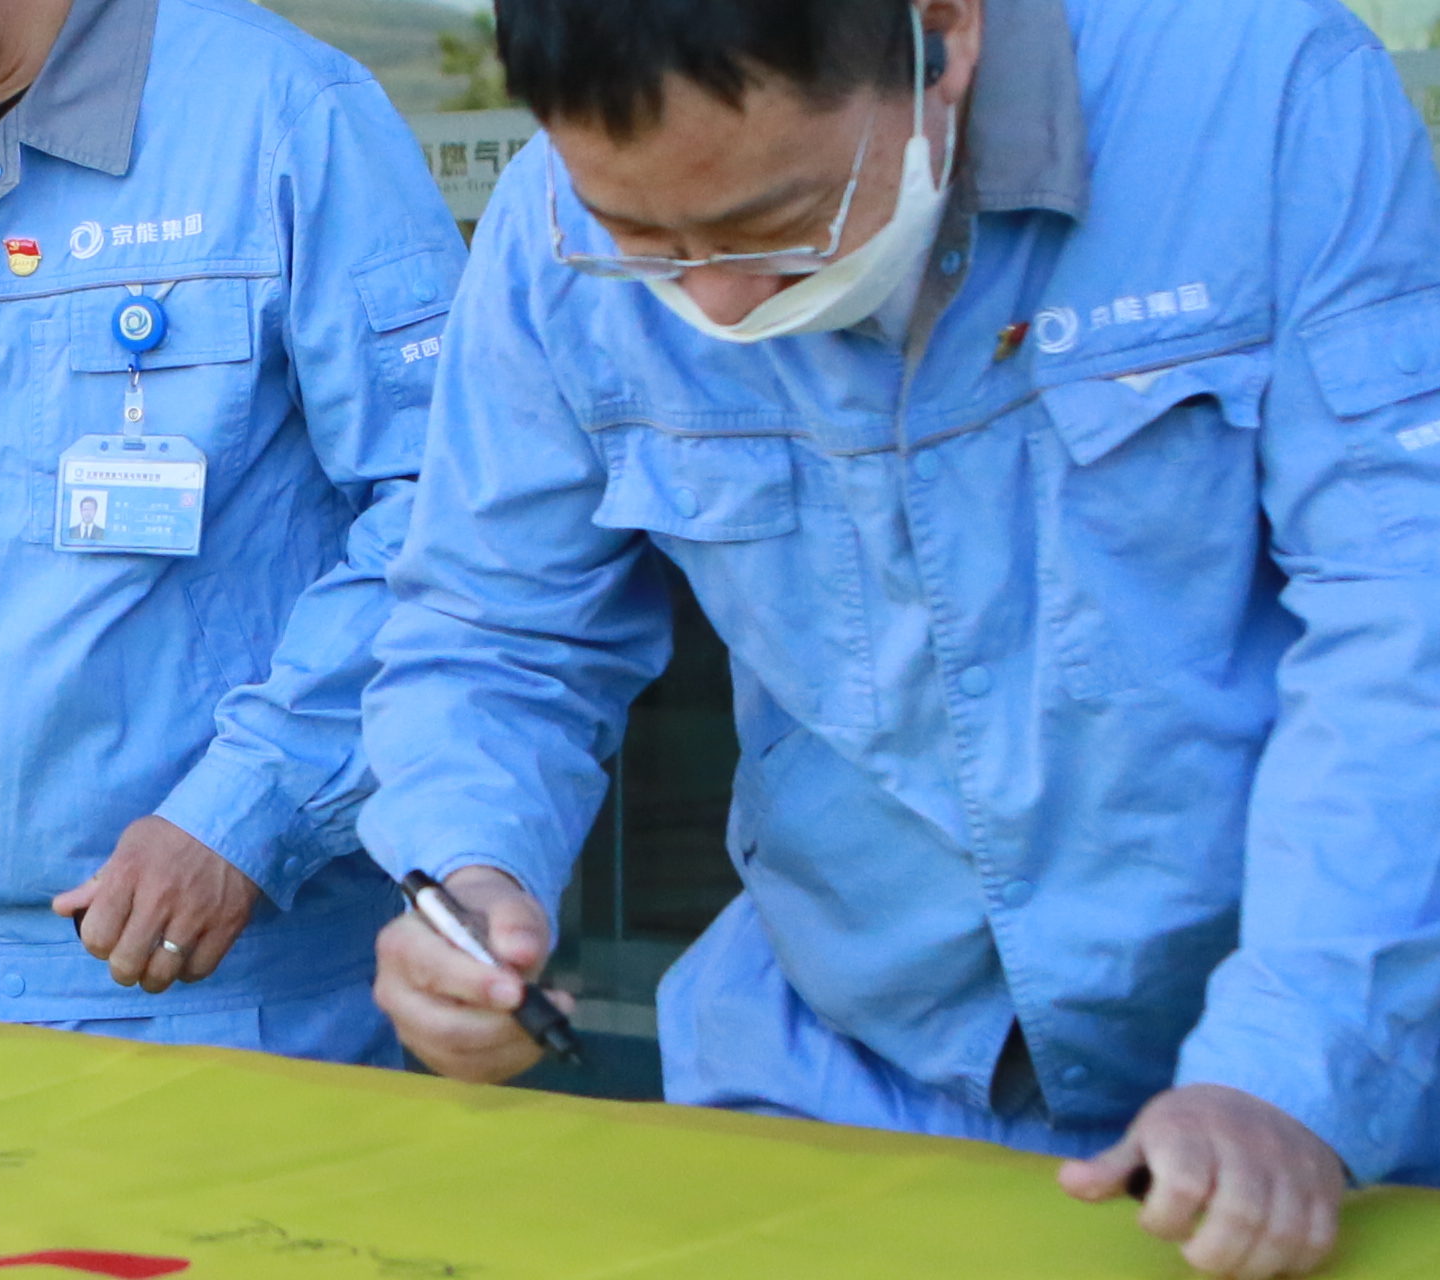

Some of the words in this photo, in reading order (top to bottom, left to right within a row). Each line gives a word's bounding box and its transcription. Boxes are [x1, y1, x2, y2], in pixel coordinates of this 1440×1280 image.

[111, 213, 203, 246] 京能集团
[400, 334, 444, 364] 京西
